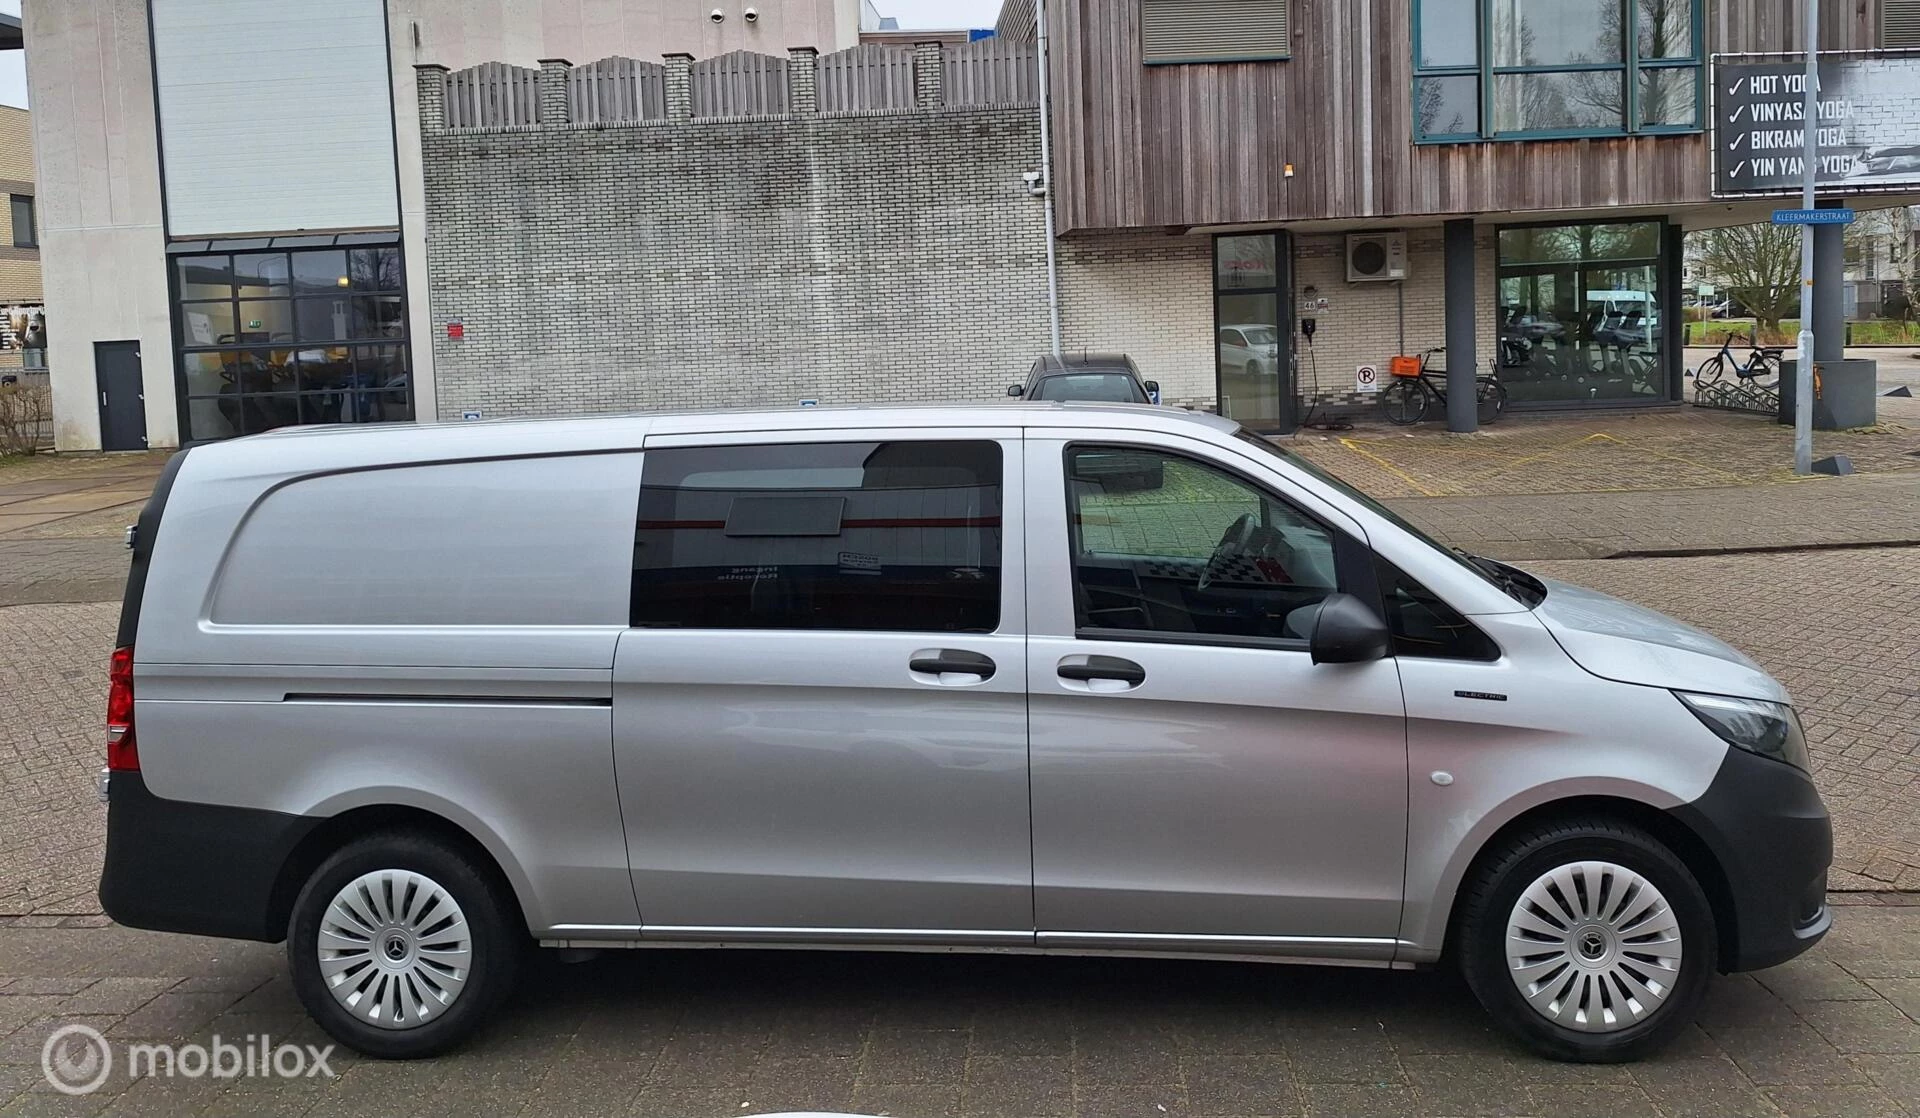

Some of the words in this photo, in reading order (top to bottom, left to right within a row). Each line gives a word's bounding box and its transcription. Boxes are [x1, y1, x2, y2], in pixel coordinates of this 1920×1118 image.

[1750, 75, 1779, 95] HOT
[1750, 102, 1807, 122] VINYAS
[1816, 100, 1855, 119] YOGA
[1751, 129, 1805, 149] BIKRAM
[1815, 128, 1847, 147] OGA
[1750, 157, 1775, 177] YIN
[1779, 156, 1817, 176] YAN
[1821, 155, 1858, 174] YOGA
[1776, 212, 1850, 221] KLEERMAKERSTRAAT
